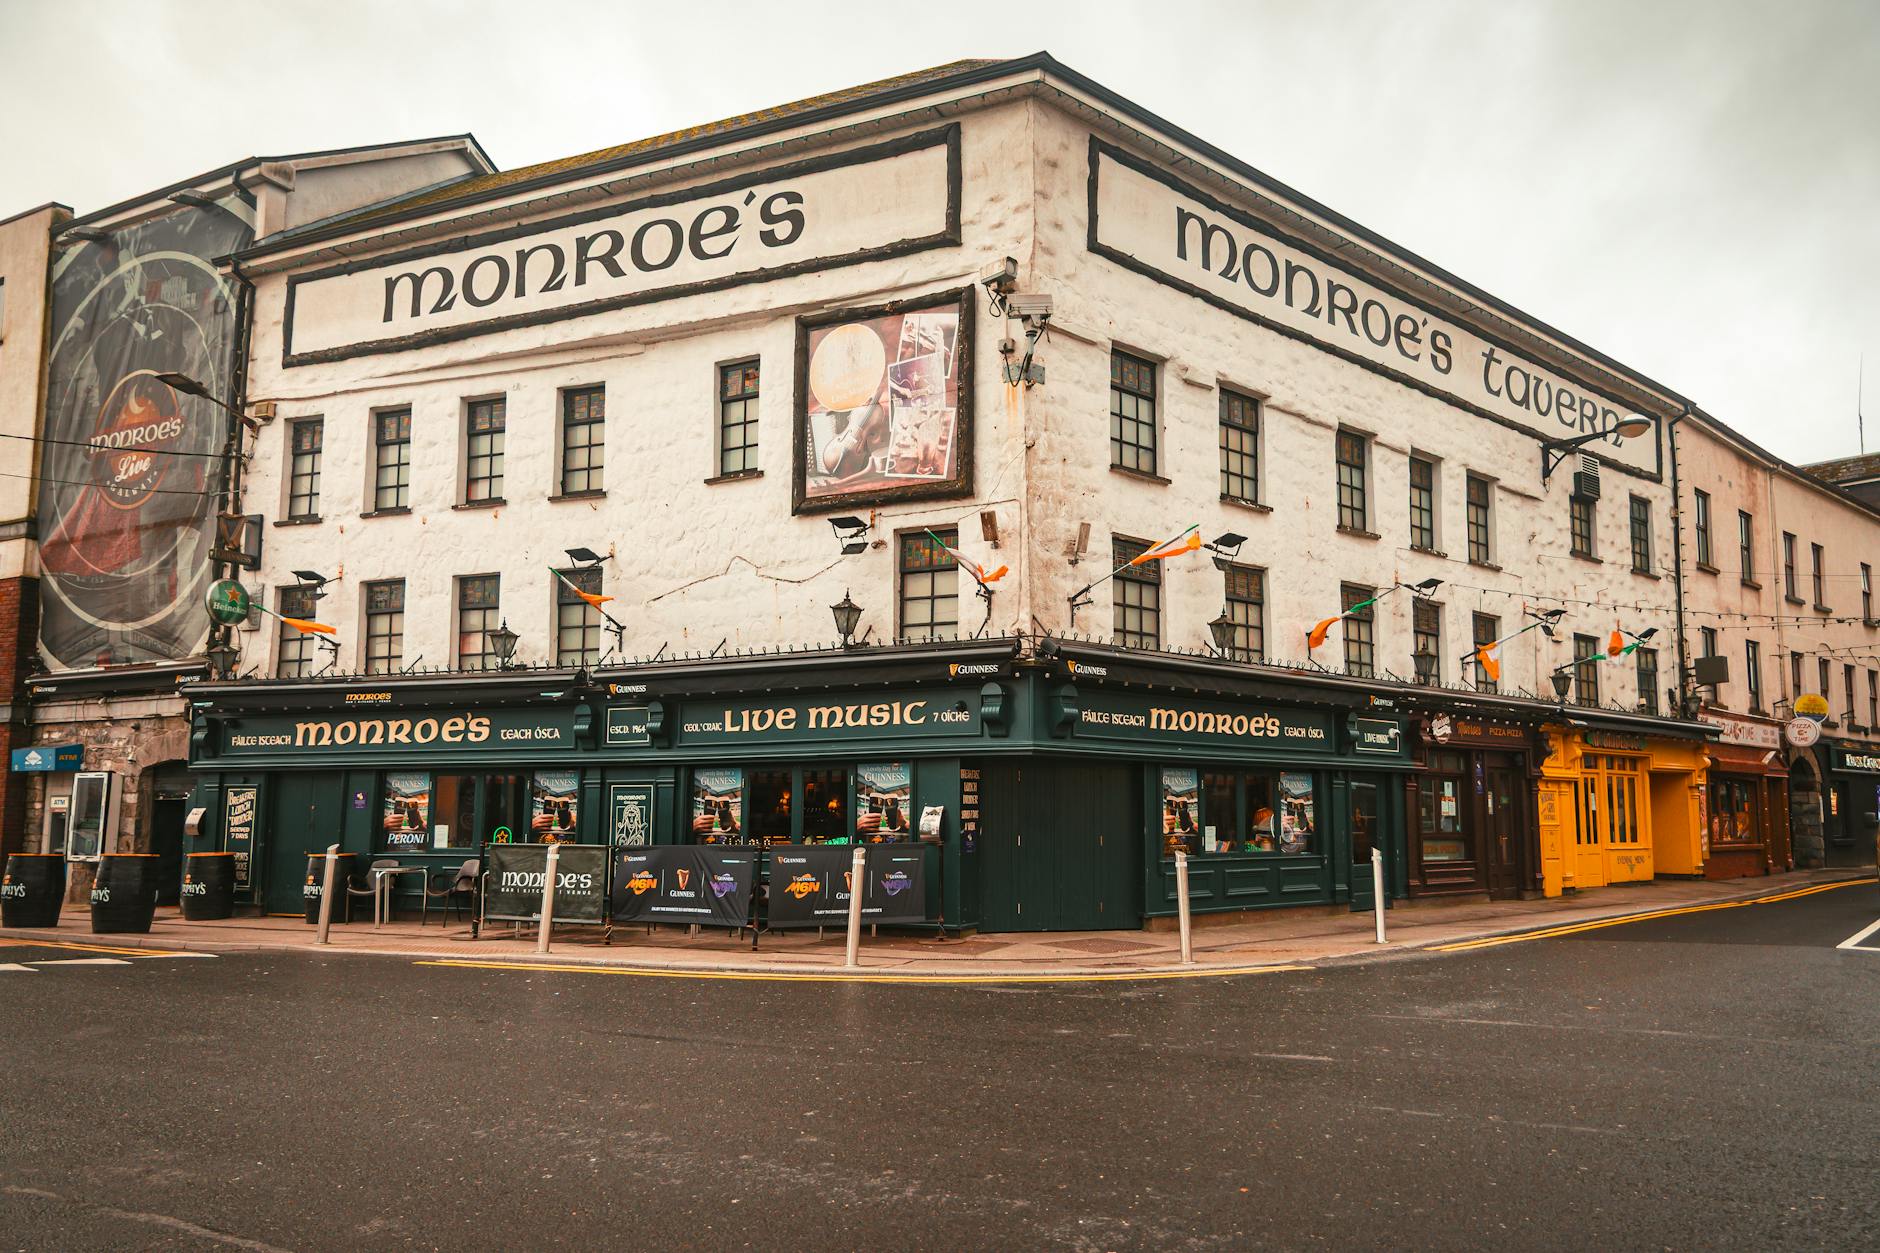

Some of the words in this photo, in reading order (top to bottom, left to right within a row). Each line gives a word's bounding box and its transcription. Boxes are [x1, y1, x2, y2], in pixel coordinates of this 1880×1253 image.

[115, 455, 151, 483] Live
[958, 664, 999, 675] GUINNESS
[1074, 663, 1107, 676] GUINNESS
[616, 684, 647, 694] GUINNESS
[724, 707, 797, 733] LIVE
[808, 701, 928, 729] MUSIC
[933, 712, 939, 722] 7
[1489, 727, 1506, 737] PIZZA
[540, 777, 577, 787] GUINNESS
[700, 776, 737, 786] GUINNESS
[864, 772, 905, 782] GUINNESS
[1162, 775, 1193, 785] GUINNESS
[391, 779, 425, 788] GUINNESS
[387, 833, 425, 845] PERONI
[669, 889, 695, 898] GUINNESS
